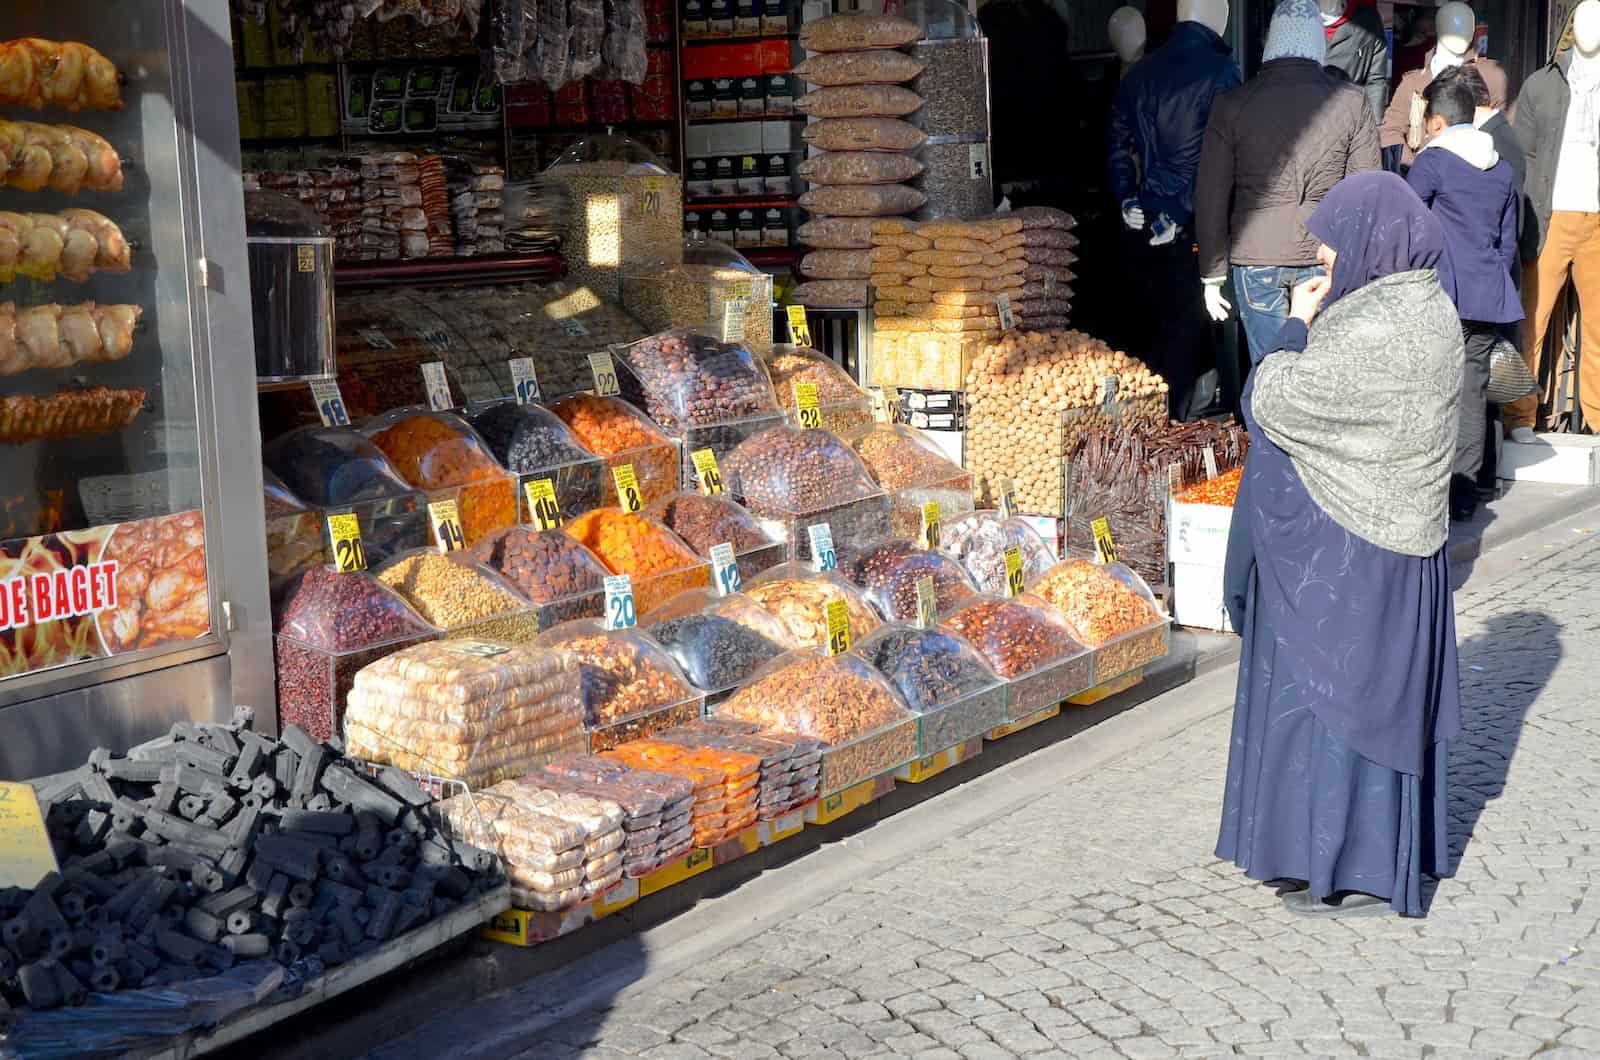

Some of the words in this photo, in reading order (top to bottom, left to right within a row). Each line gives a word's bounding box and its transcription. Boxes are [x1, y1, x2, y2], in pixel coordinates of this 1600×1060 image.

[517, 379, 541, 403] 12
[599, 373, 618, 394] 22
[704, 471, 724, 495] 14
[535, 497, 560, 530] 14
[626, 488, 640, 511] 8
[439, 520, 466, 551] 14
[1099, 536, 1115, 563] 14
[336, 539, 368, 571] 20
[819, 550, 836, 571] 30
[35, 563, 116, 620] BAGET
[720, 563, 741, 593] 12
[611, 595, 635, 627] 20
